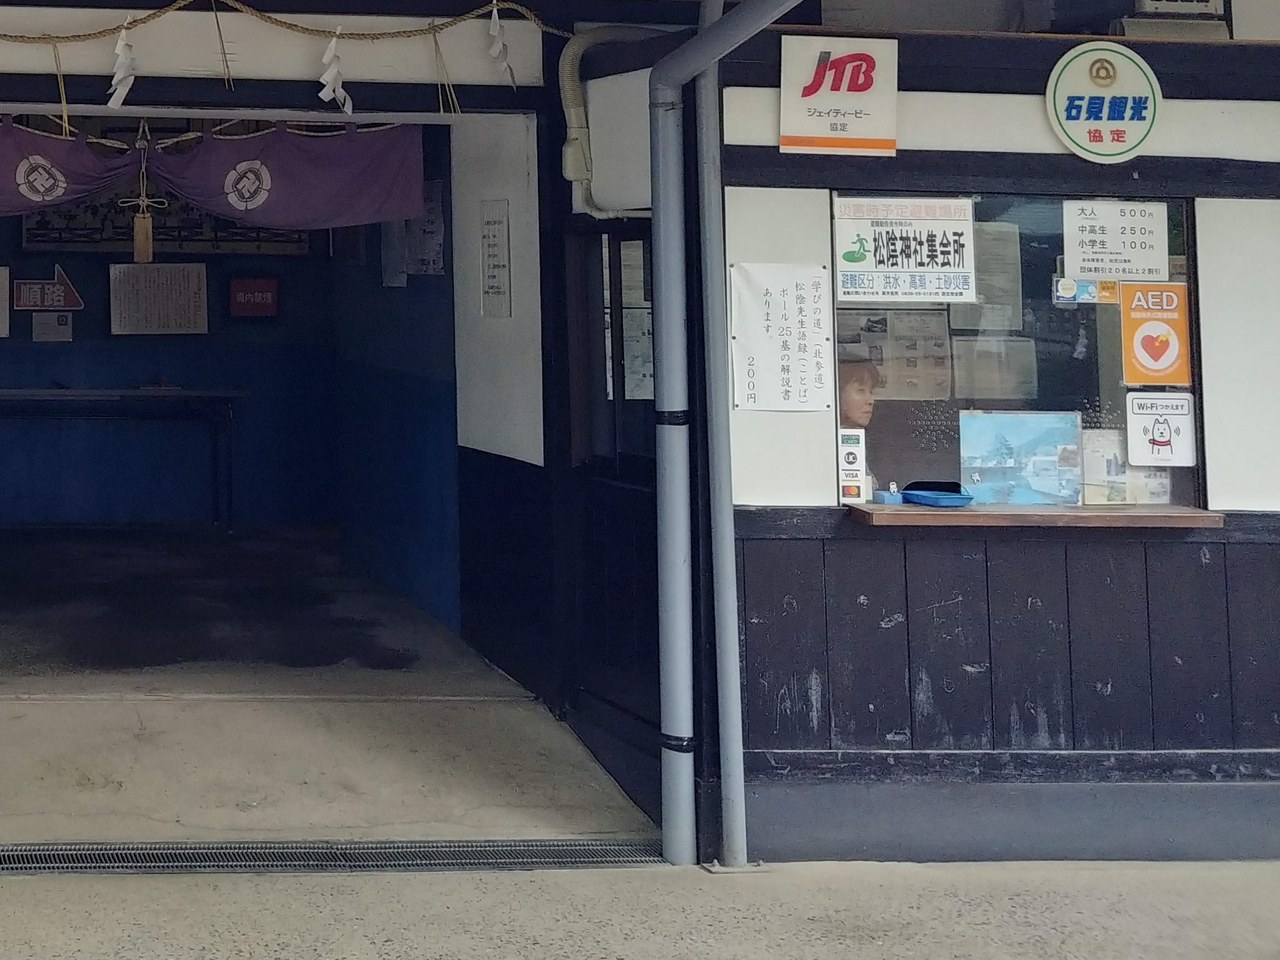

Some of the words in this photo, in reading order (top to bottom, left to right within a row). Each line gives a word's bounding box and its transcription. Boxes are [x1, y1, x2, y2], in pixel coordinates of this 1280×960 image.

[801, 50, 876, 98] JTB
[806, 107, 871, 119] ジェイティービー
[1064, 95, 1150, 121] 石見観光
[829, 122, 848, 132] 協定
[1087, 128, 1127, 143] 協定
[1077, 206, 1097, 217] 大人
[1119, 208, 1154, 218] 500円
[1077, 224, 1108, 235] 中高生
[1120, 226, 1154, 236] 250円
[873, 228, 965, 269] 松陰神社集会所
[1077, 239, 1108, 250] 小学生
[1120, 240, 1155, 251] 100円
[20, 283, 65, 307] 順路
[1130, 290, 1179, 310] AED
[746, 355, 757, 404] 200円
[1137, 401, 1185, 412] Wi-Fiつかえます
